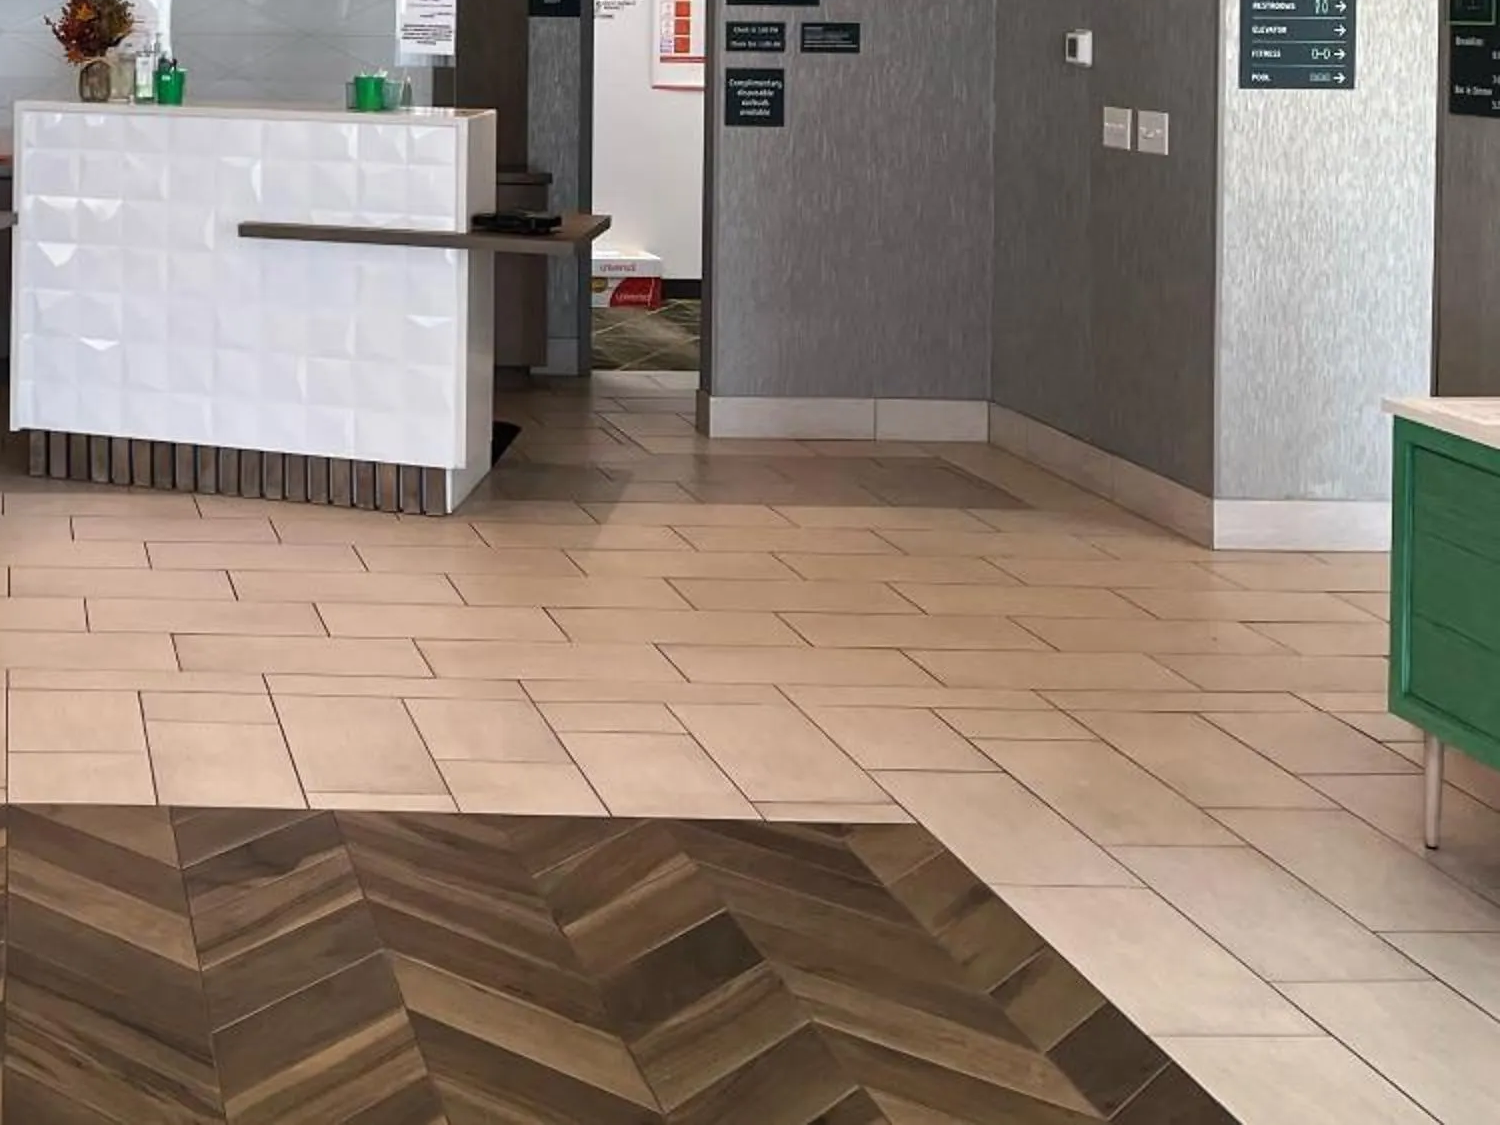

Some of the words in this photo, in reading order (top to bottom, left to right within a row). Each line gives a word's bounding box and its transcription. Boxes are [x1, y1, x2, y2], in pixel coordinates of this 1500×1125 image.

[1252, 2, 1296, 10] RESTROOMS
[1251, 26, 1288, 34] ELEVATOR
[1251, 49, 1281, 58] FITNESS
[1251, 73, 1271, 82] POOL
